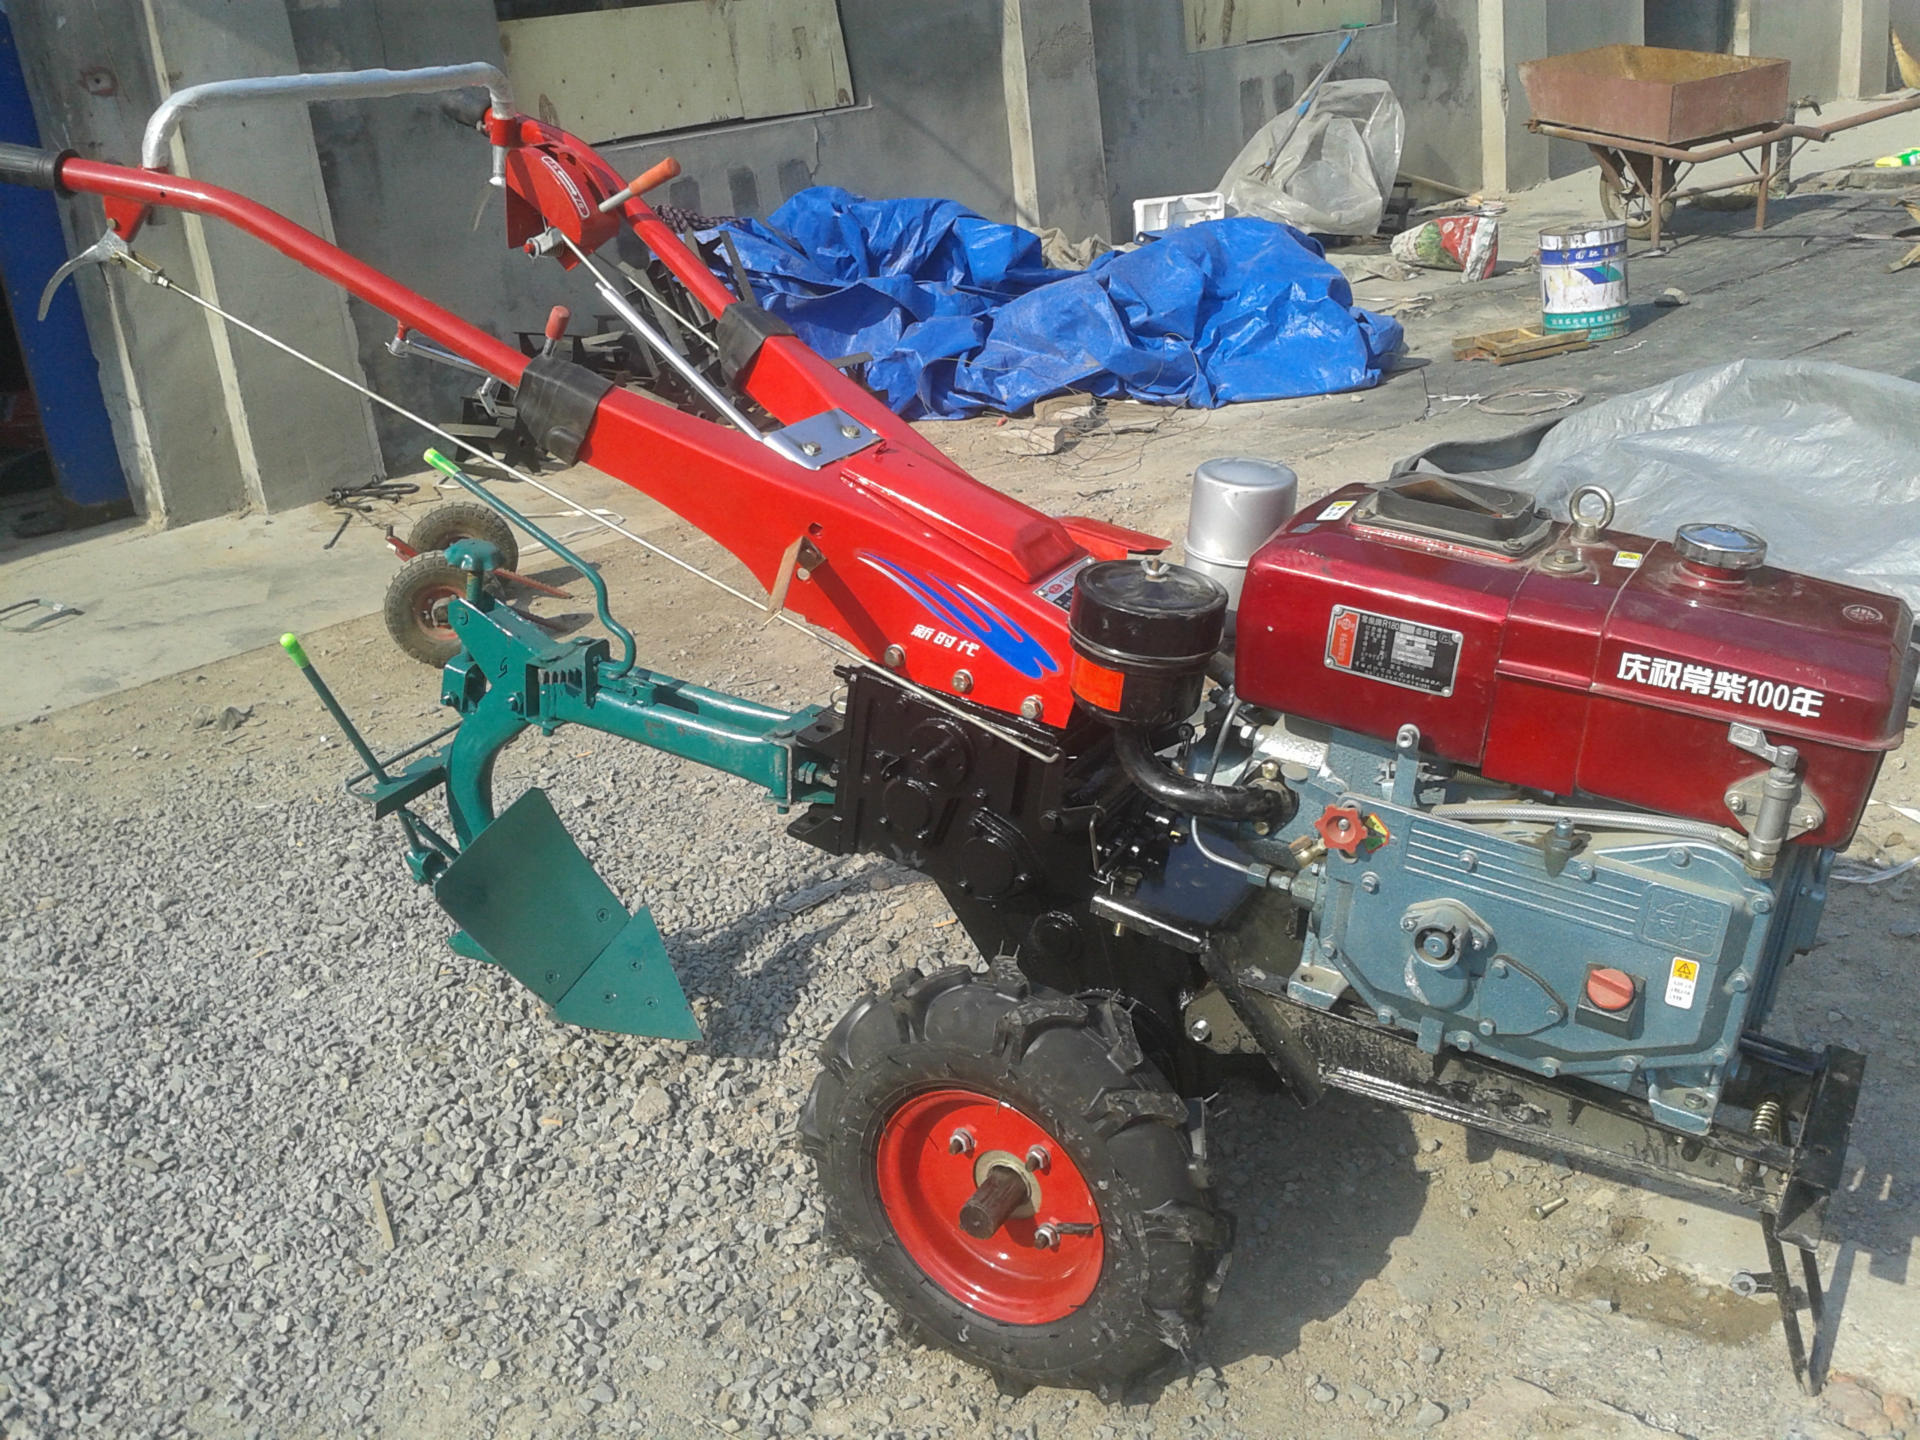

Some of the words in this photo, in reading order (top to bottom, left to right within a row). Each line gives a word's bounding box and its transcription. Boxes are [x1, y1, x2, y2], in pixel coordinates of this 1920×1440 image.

[910, 623, 981, 657] 新时代
[1616, 652, 1825, 718] 庆祝常柴100年
